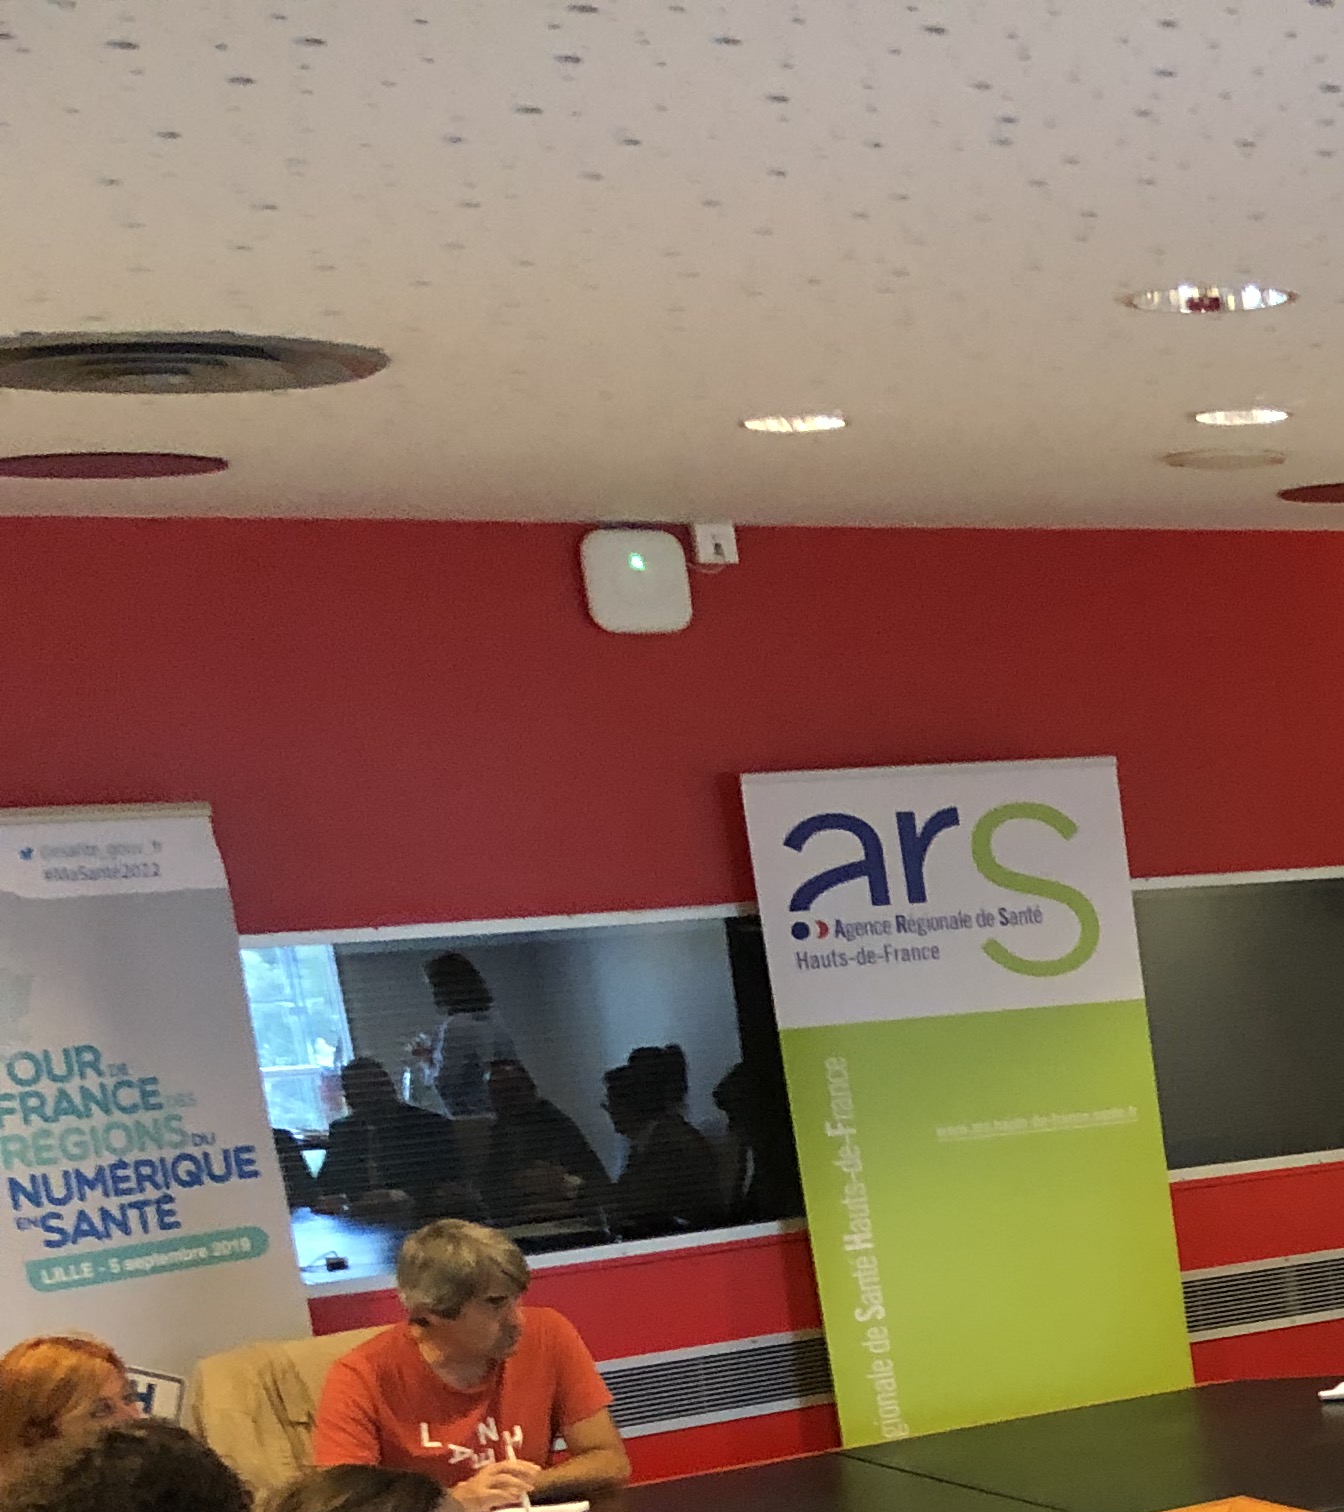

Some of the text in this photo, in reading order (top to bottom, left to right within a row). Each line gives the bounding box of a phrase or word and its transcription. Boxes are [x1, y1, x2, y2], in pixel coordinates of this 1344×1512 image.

[783, 801, 1101, 978] ars
[833, 904, 1044, 942] Agence Régionale de Santé
[795, 943, 941, 971] Hauts-de-France
[5, 1044, 105, 1087] OUR
[0, 1076, 164, 1128] FRANCE
[7, 1145, 262, 1212] NUMÉRIQUE
[41, 1191, 182, 1249] SANTÉ
[40, 1261, 95, 1285] LILLE
[824, 1055, 910, 1441] gionale de Santé Hauts-de-France
